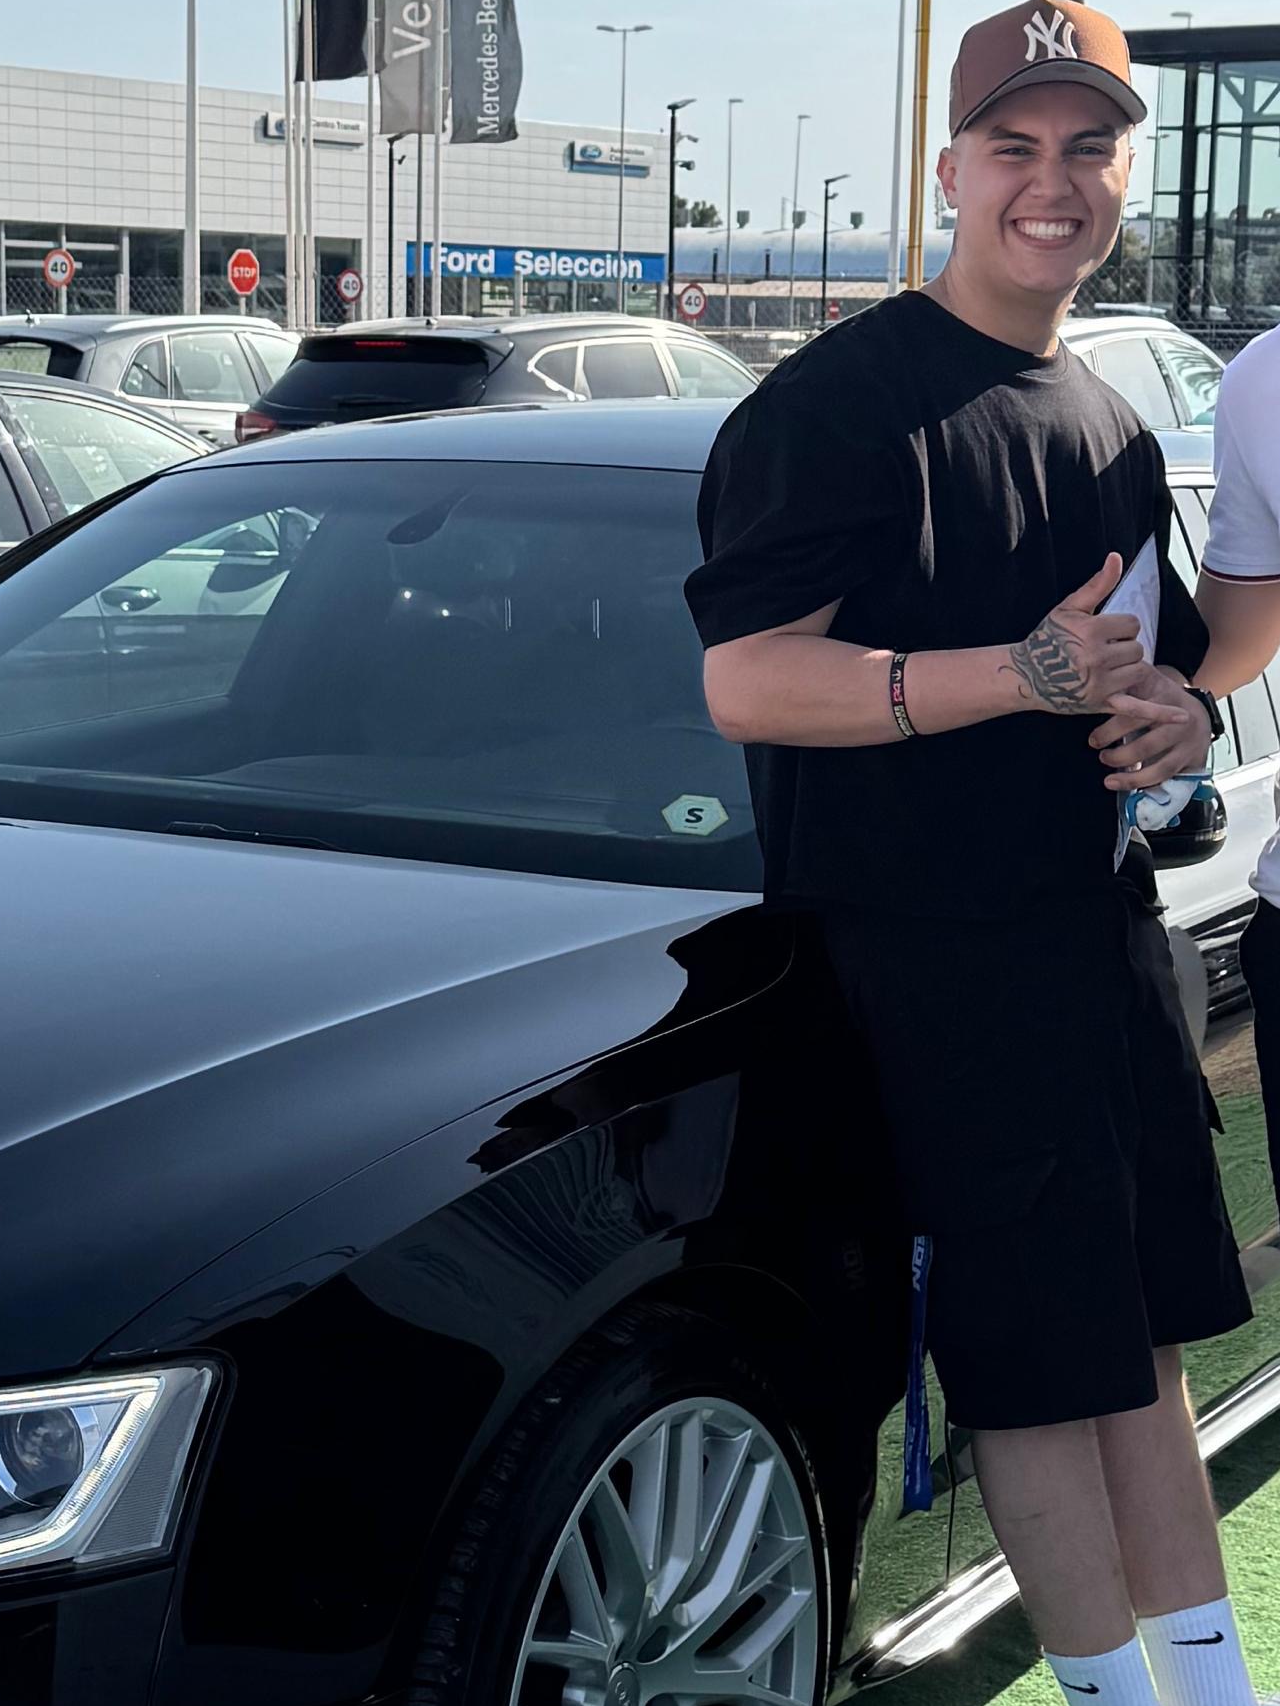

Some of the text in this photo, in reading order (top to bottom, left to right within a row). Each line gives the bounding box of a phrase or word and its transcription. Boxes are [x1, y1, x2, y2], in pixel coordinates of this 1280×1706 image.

[1023, 9, 1078, 62] NY
[50, 261, 68, 274] 40
[430, 247, 496, 275] Ford
[232, 266, 256, 278] STOP
[343, 279, 358, 291] 40
[684, 295, 701, 307] 40
[685, 807, 705, 824] S
